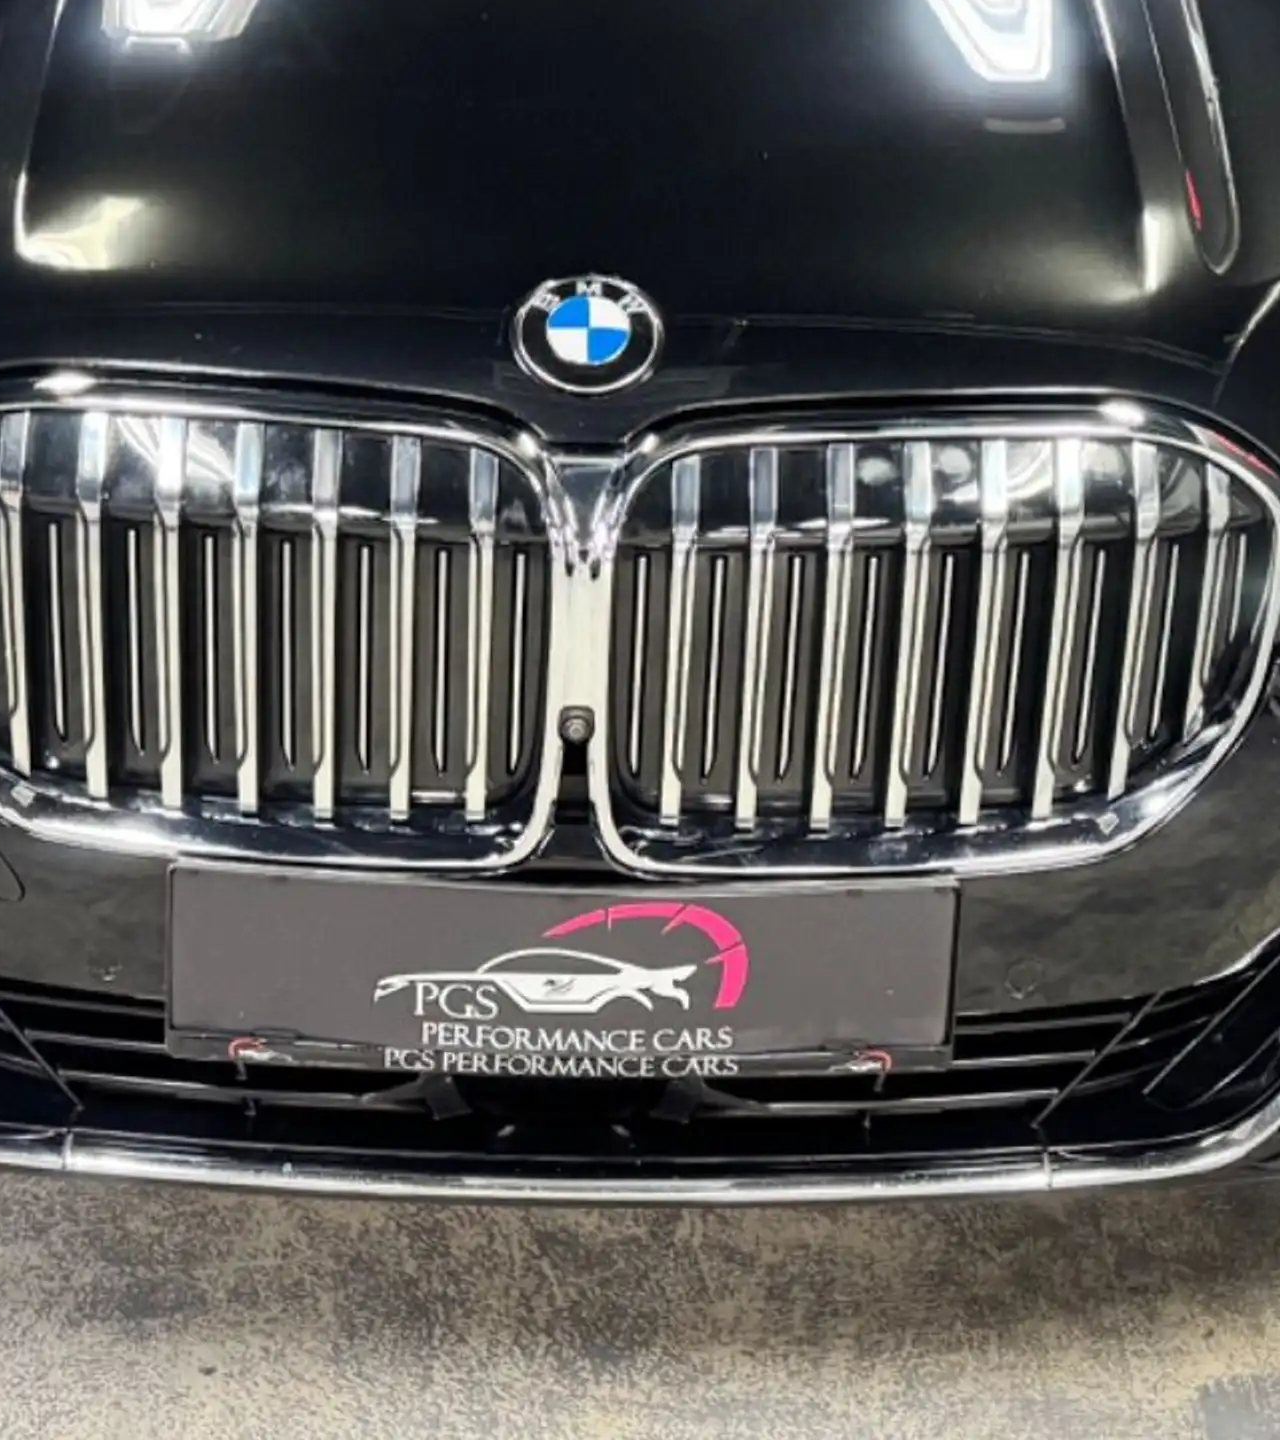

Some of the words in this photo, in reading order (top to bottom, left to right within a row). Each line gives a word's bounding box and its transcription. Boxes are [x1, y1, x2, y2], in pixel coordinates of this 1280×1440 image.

[530, 280, 649, 313] BMW
[413, 982, 499, 1020] PGS
[422, 1021, 646, 1053] PERFORMANCE
[653, 1025, 733, 1052] CARS
[384, 1047, 435, 1071] PGS
[443, 1051, 655, 1077] PERFORMANCE
[662, 1054, 738, 1077] CARS
